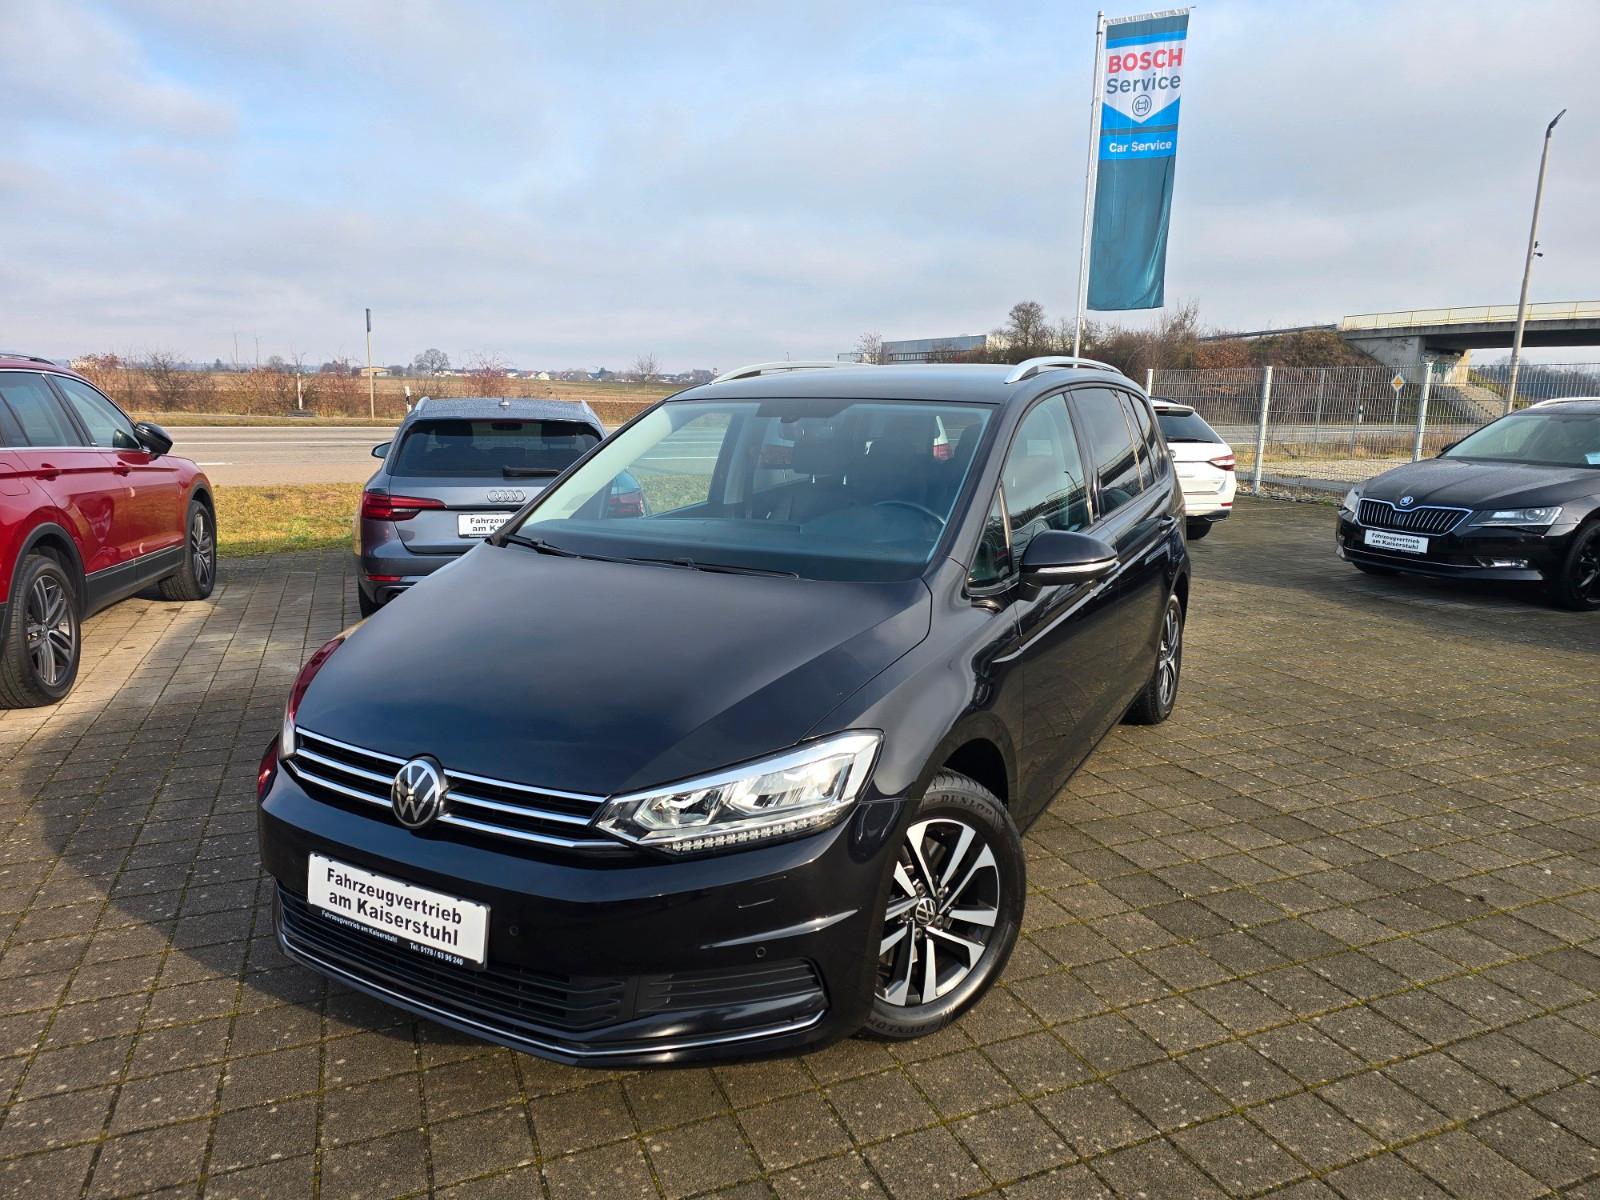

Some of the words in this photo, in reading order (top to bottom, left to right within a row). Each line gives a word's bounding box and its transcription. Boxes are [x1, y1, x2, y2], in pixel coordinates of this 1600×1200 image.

[1108, 48, 1183, 74] BOSCH
[1106, 72, 1181, 94] Service
[1109, 142, 1129, 153] Car
[1131, 140, 1172, 152] Service
[327, 868, 462, 924] Fahrzeugvertrieb
[321, 910, 360, 930] Fahrzeugvertrieb
[328, 891, 352, 910] am
[357, 898, 458, 945] Kaiserstuhl
